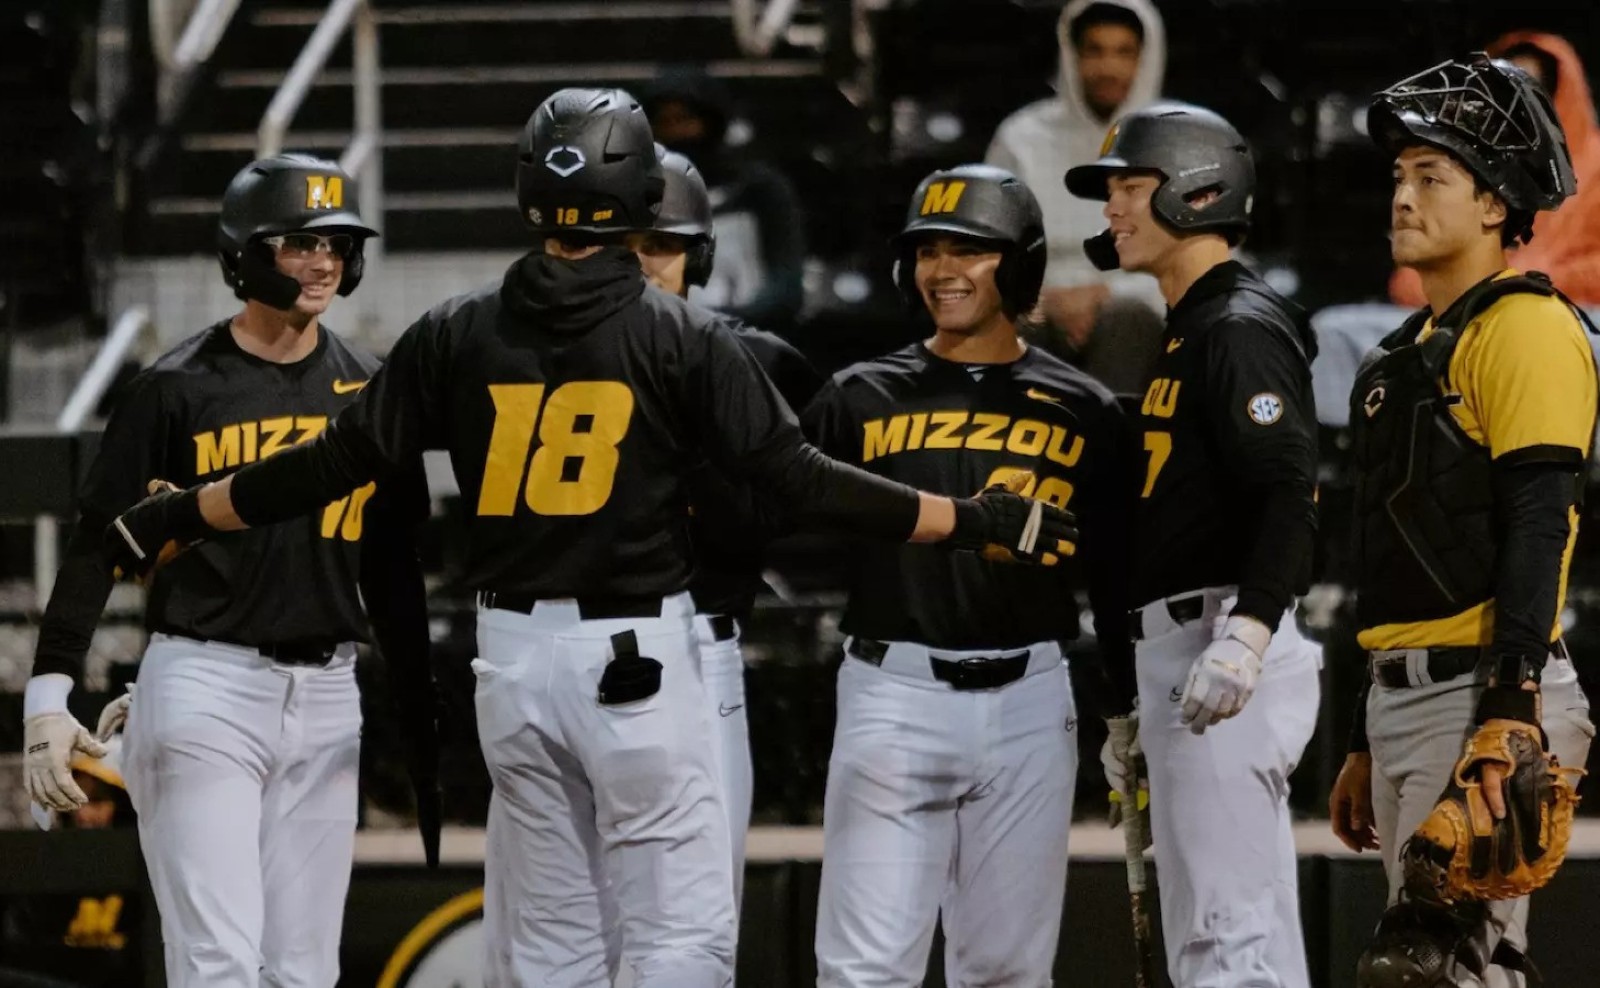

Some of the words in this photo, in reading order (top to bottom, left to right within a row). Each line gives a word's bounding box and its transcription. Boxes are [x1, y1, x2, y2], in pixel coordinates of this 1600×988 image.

[306, 176, 343, 209] M
[920, 180, 966, 216] M
[556, 207, 579, 226] 18
[477, 380, 634, 517] 18
[863, 411, 1085, 468] MIZZOU
